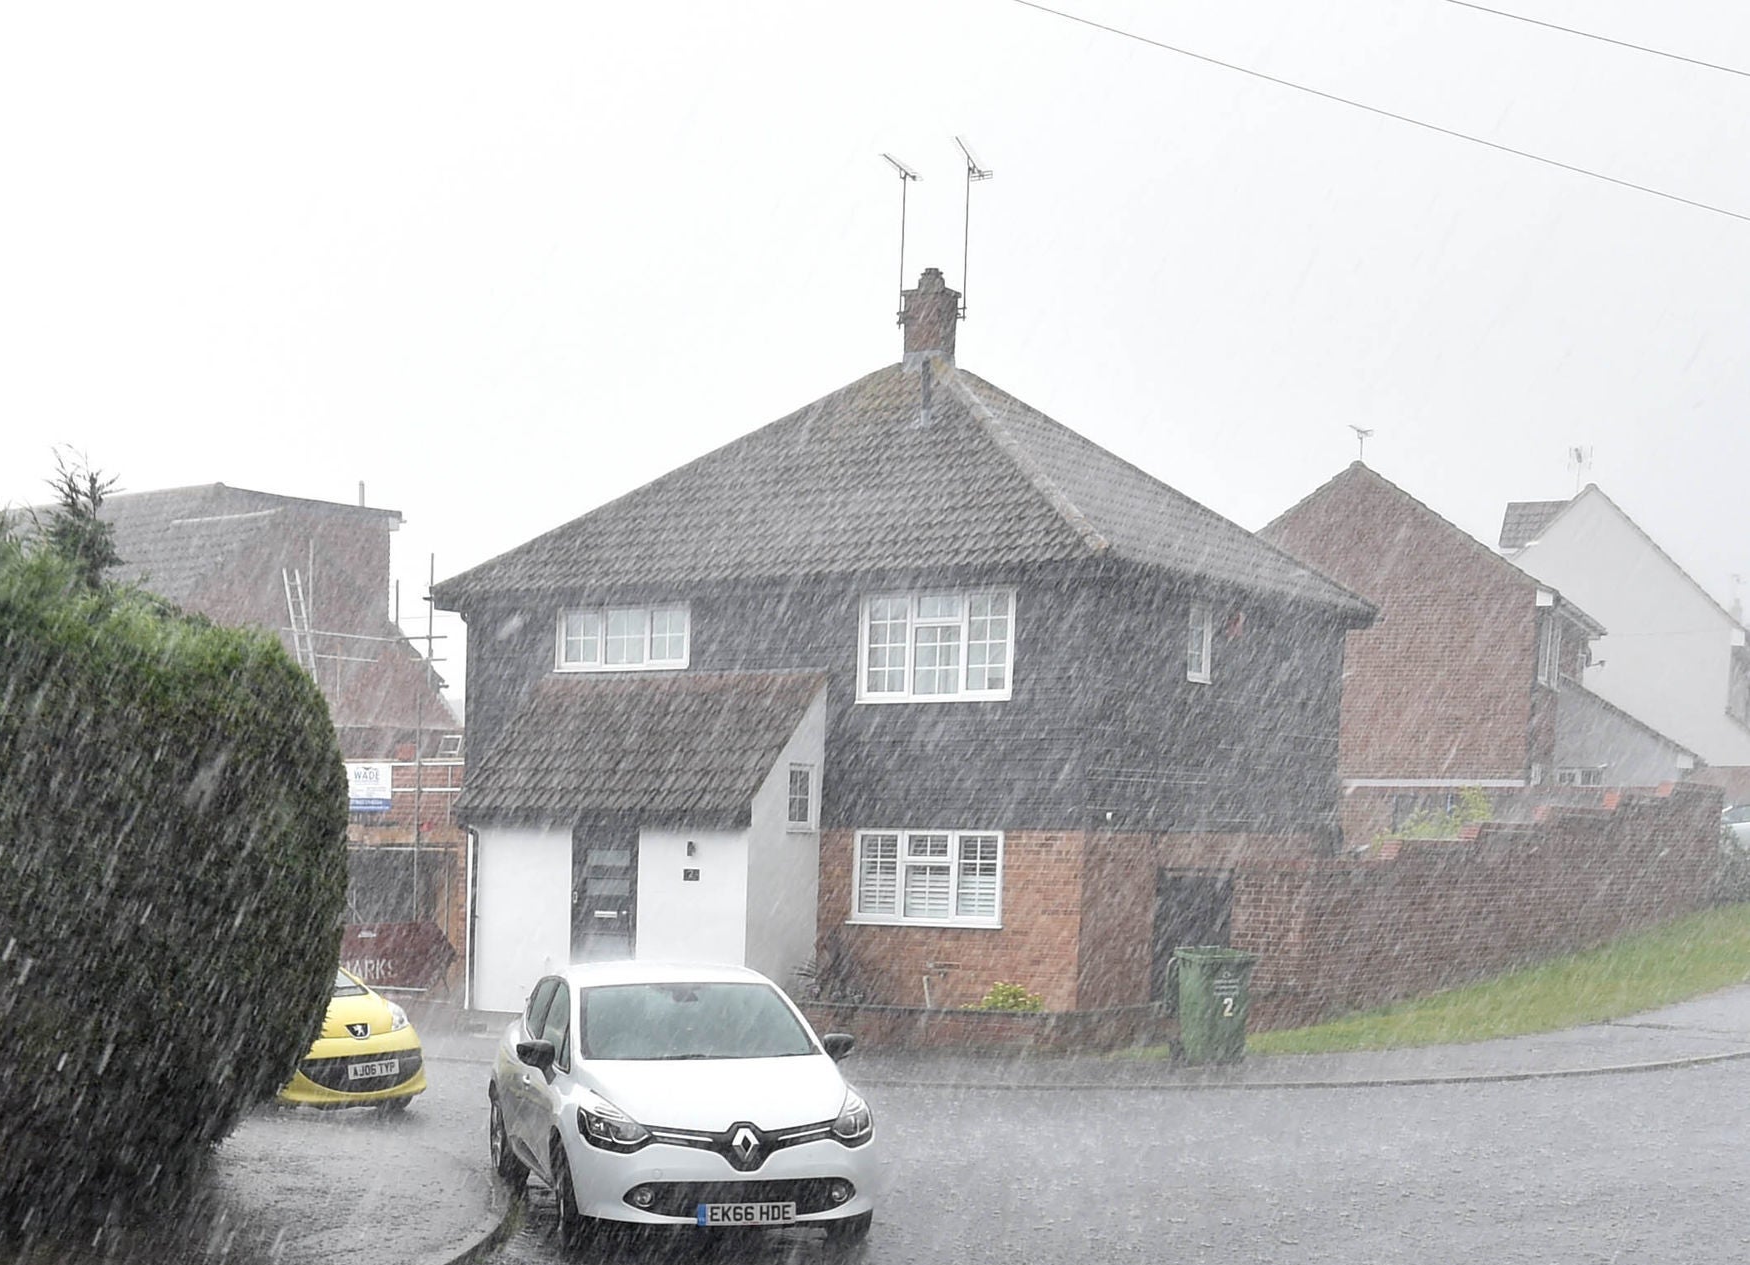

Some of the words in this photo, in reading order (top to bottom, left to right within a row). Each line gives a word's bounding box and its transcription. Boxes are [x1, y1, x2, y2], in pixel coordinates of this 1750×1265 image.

[1223, 998, 1234, 1017] 2
[352, 1063, 377, 1077] AJ06
[378, 1061, 395, 1074] TYP
[710, 1206, 755, 1222] EK66
[759, 1205, 792, 1220] HDE
